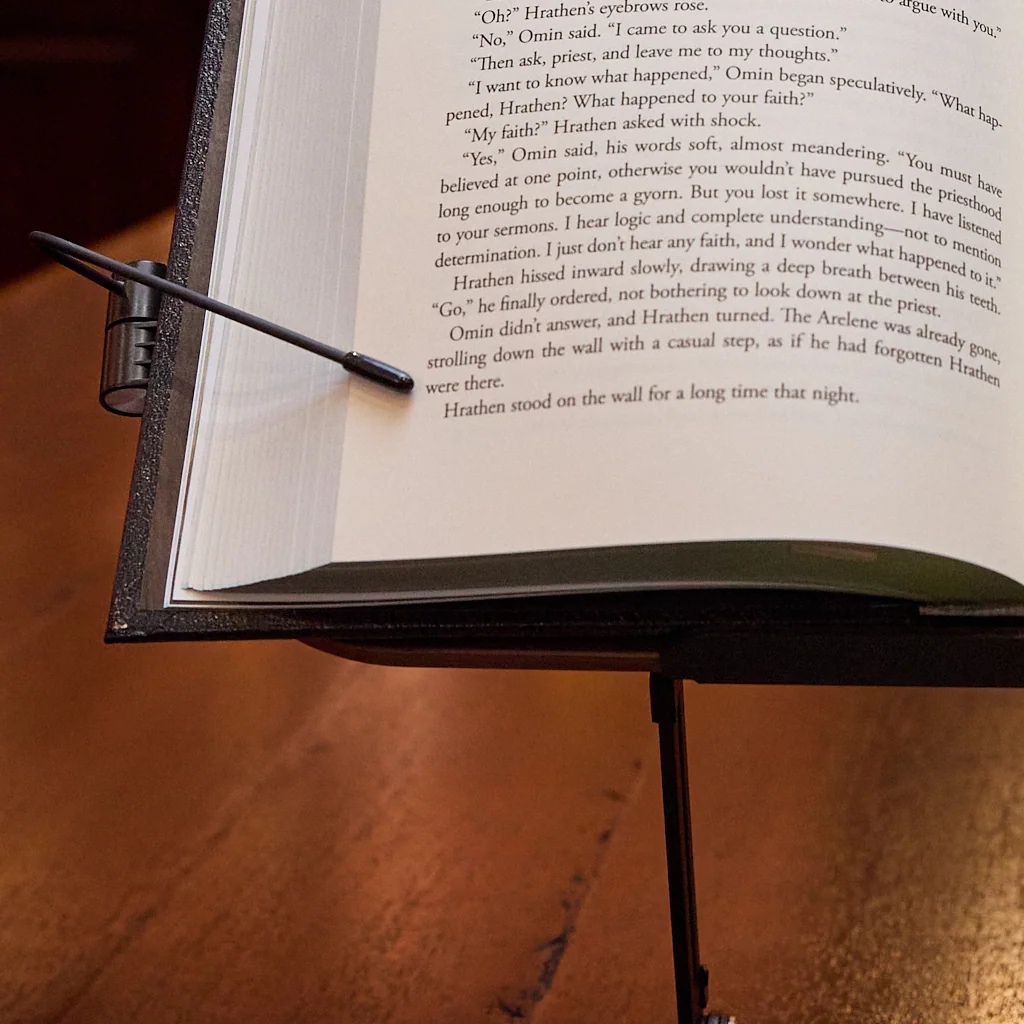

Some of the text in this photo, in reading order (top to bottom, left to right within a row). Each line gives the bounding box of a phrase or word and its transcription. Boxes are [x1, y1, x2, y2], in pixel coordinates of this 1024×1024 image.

[674, 2, 708, 11] rose.
[518, 28, 563, 44] Omin
[568, 23, 601, 40] said.
[626, 25, 667, 36] came
[672, 24, 687, 34] to
[692, 19, 717, 34] ask
[721, 25, 750, 38] you
[756, 25, 764, 35] a
[440, 173, 499, 194] believed
[504, 176, 519, 187] at
[524, 173, 551, 185] one
[556, 167, 602, 187] point,
[608, 162, 683, 178] otherwise
[688, 165, 717, 179] you
[801, 162, 836, 179] have
[842, 171, 904, 189] pursued
[910, 177, 933, 195] the
[938, 189, 1002, 222] priesthood
[425, 374, 504, 394] were there.
[444, 382, 859, 418] Hrathen stood on the wall for a long time that night.
